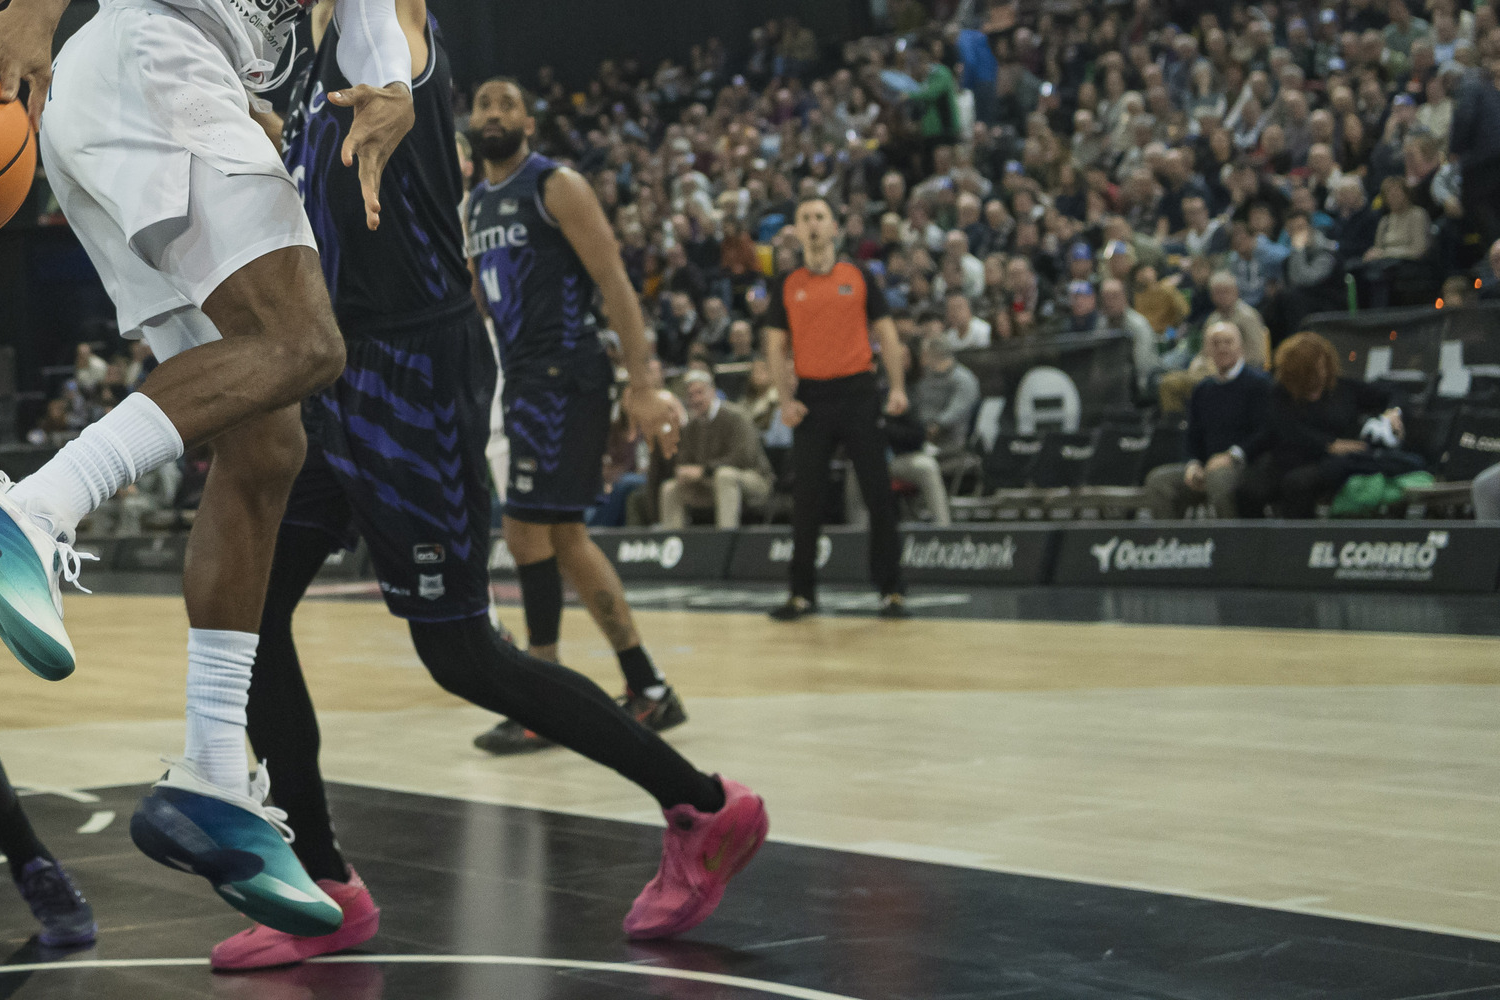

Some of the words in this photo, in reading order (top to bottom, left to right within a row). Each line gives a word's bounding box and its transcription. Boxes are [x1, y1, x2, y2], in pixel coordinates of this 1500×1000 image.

[1113, 537, 1214, 570] Occident
[1308, 541, 1336, 568] EL
[1338, 540, 1438, 569] CORREO
